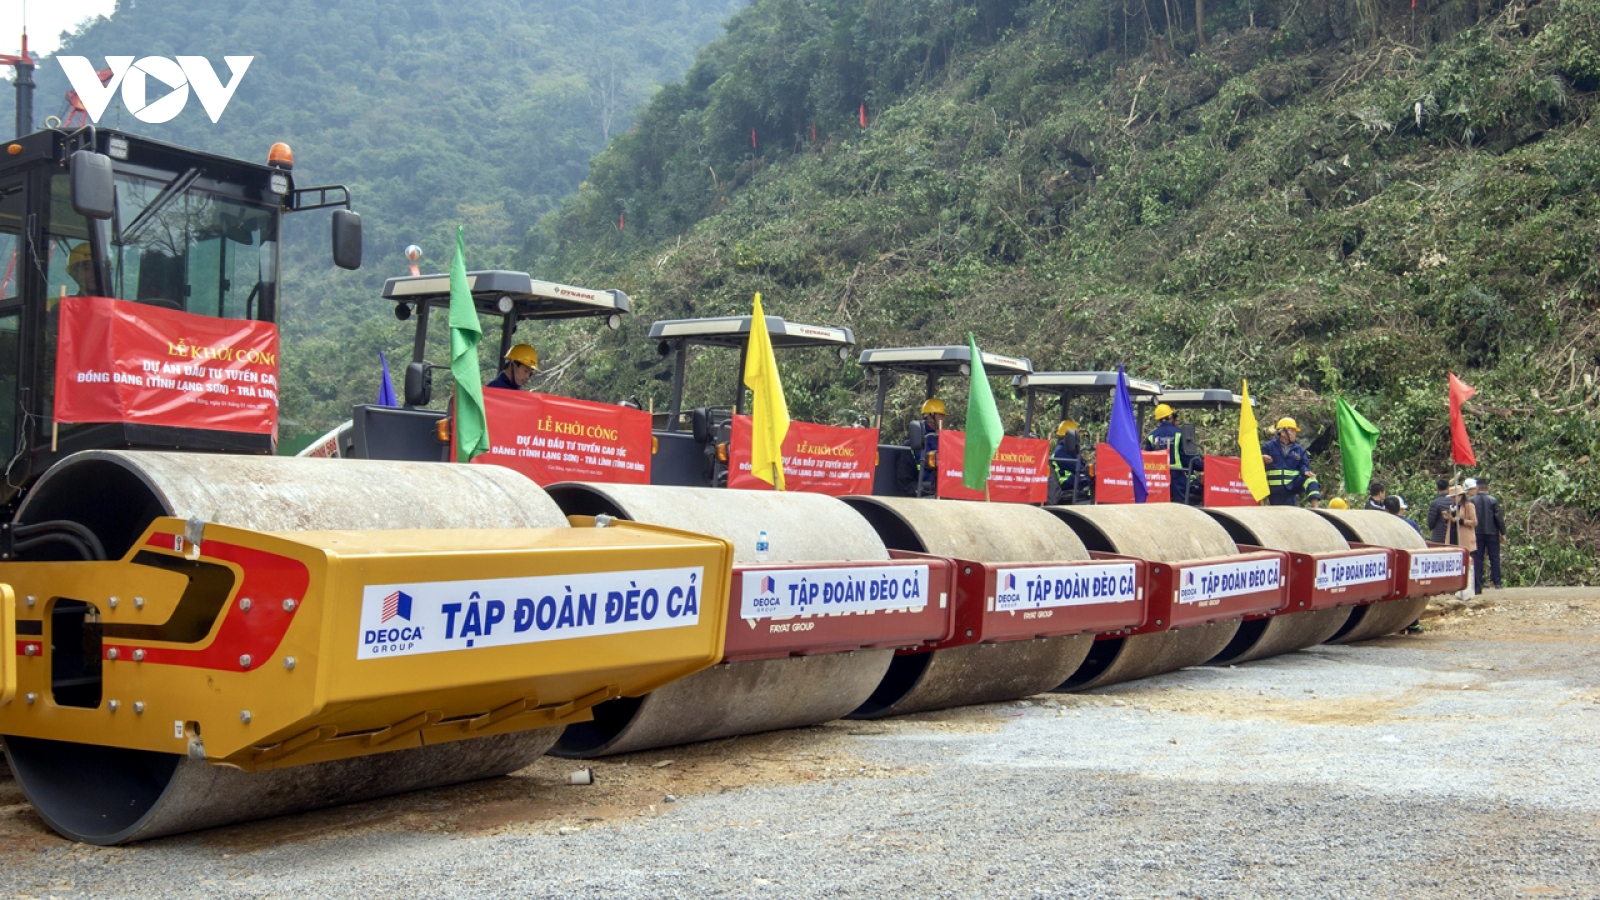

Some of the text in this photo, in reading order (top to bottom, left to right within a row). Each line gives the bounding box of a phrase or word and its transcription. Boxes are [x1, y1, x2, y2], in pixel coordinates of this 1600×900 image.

[560, 289, 596, 300] DYNAPAC
[163, 361, 180, 374] ÁN
[586, 425, 618, 440] CÔNG
[1201, 562, 1278, 598] TẬP ĐOÀN ĐÈO CẢ
[1331, 563, 1345, 586] TẬP
[1345, 561, 1364, 581] ĐOÀN
[1364, 560, 1376, 578] ĐÈO
[788, 570, 920, 612] TẬP ĐOÀN ĐÈO CẢ
[1026, 568, 1134, 607] TẬP ĐOÀN ĐÈO CẢ
[441, 573, 697, 647] TẬP ĐOÀN ĐÈO CẢ
[753, 598, 780, 607] DEOCA
[792, 622, 815, 632] GROUP
[364, 627, 422, 645] DEOCA
[372, 643, 414, 654] GROUP
